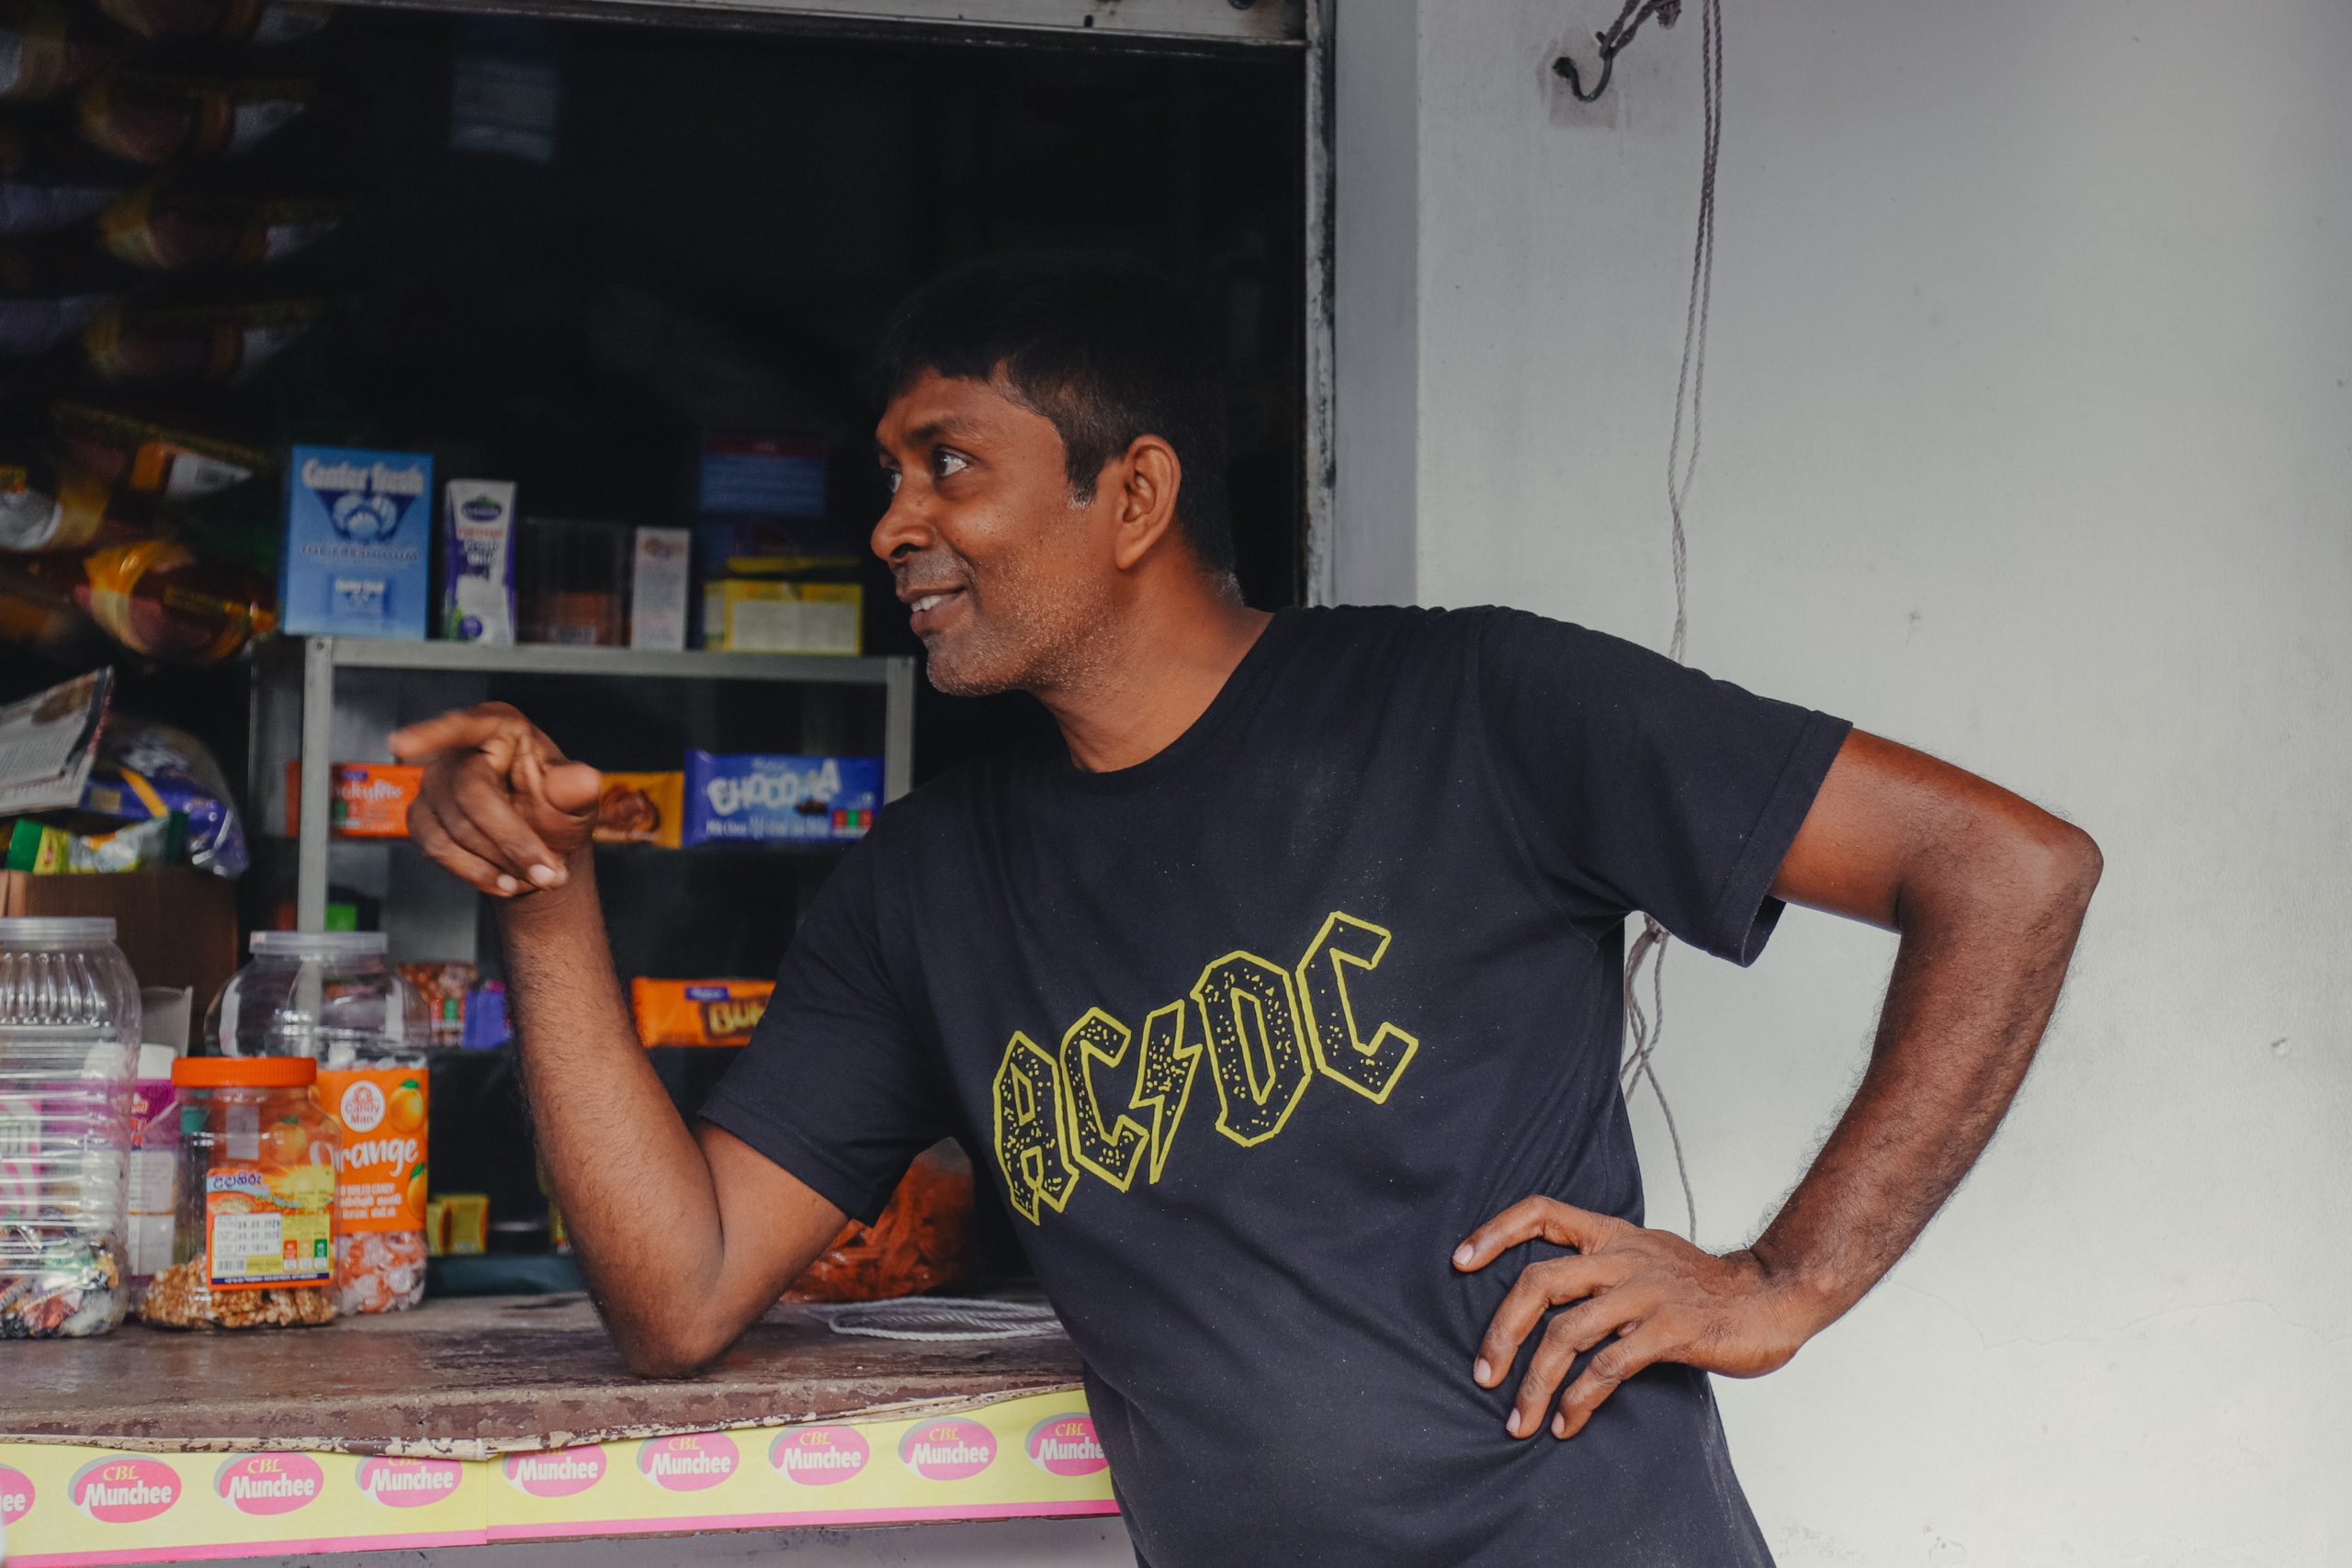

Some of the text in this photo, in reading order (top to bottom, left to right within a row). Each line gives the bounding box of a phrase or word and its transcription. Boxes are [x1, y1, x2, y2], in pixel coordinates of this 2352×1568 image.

[345, 1101, 380, 1115] Candy
[371, 1182, 396, 1195] CANDY
[929, 1427, 960, 1441] CBL
[1055, 1423, 1087, 1437] CBL
[669, 1437, 701, 1451] CBL
[799, 1432, 832, 1446] CBL
[783, 1445, 862, 1470] Munchee
[912, 1440, 989, 1465] Munchee
[247, 1458, 283, 1473] CBL
[517, 1456, 598, 1481] Munchee
[652, 1450, 731, 1475] Munchee
[103, 1465, 139, 1481] CBL
[371, 1466, 454, 1492] Munchee
[84, 1480, 173, 1506] Munchee
[231, 1472, 315, 1498] Munchee
